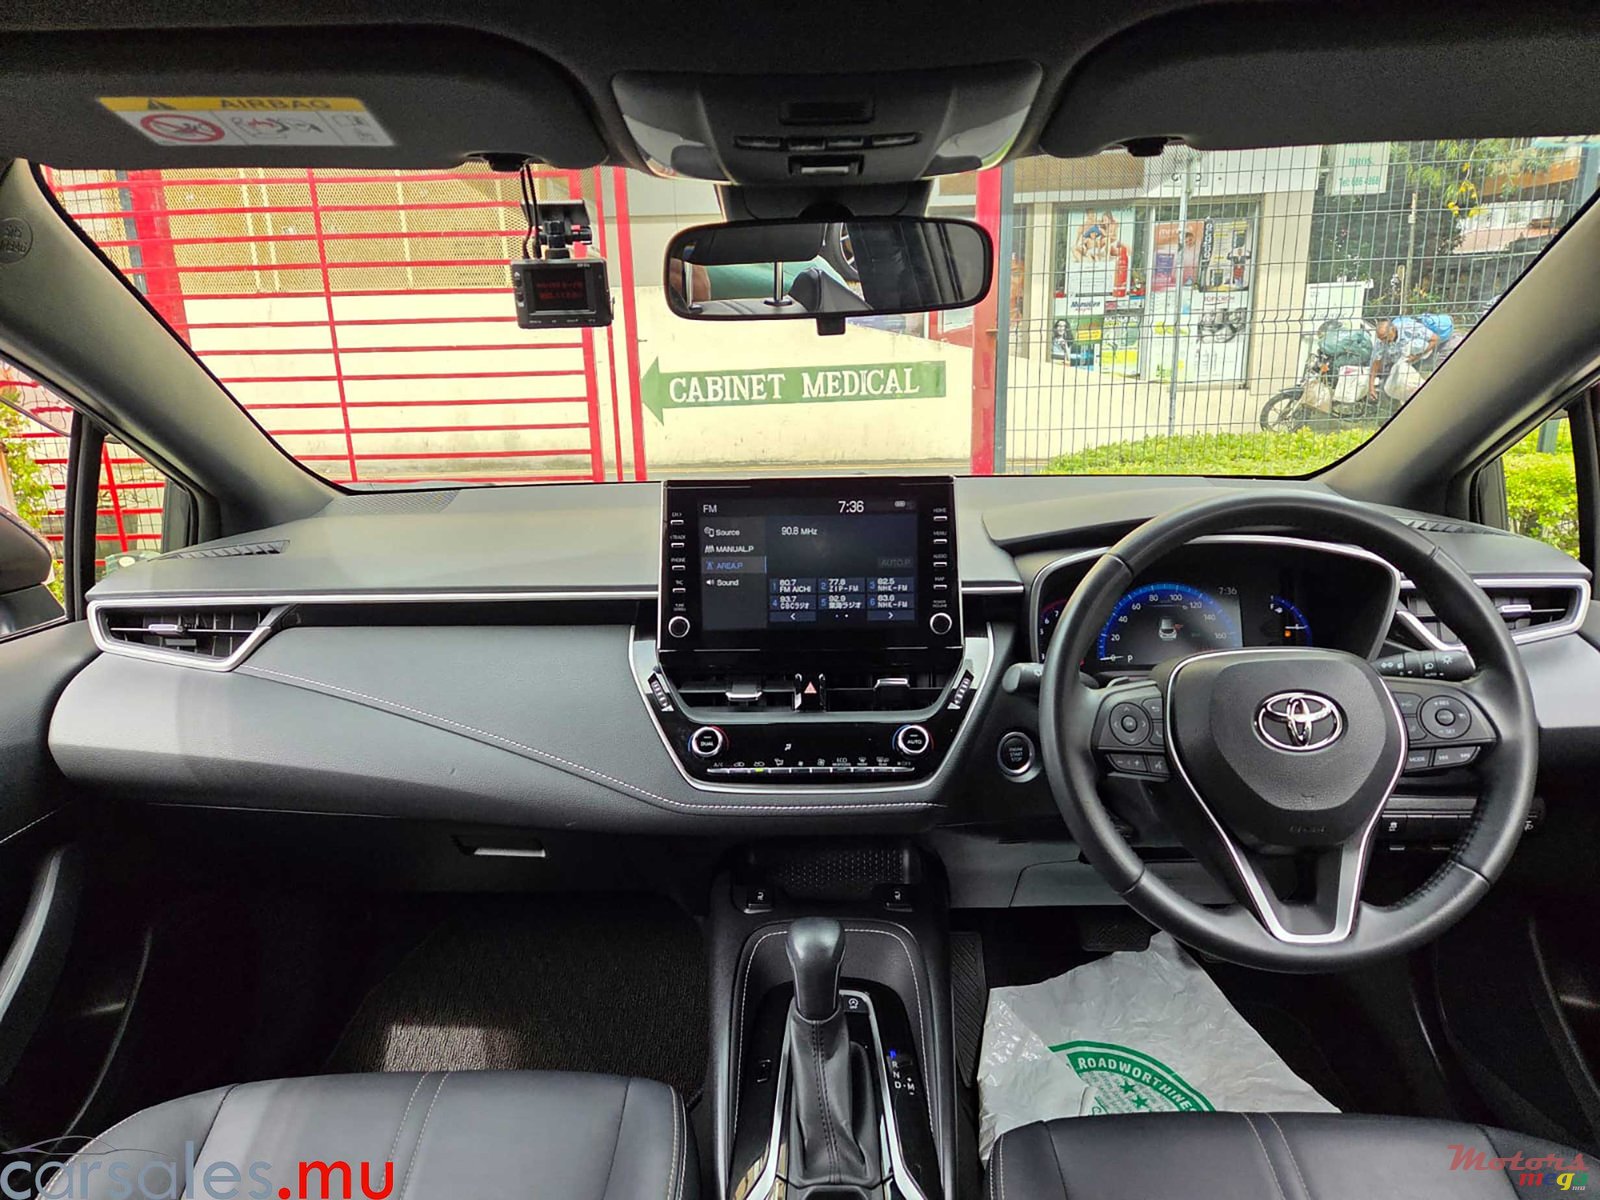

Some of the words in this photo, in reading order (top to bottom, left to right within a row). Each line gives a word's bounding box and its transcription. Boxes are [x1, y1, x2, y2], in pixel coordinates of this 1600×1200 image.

[220, 99, 332, 109] AIRBAG
[668, 374, 786, 404] CABINET
[801, 368, 920, 399] MEDICAL
[703, 505, 718, 513] FM
[838, 501, 865, 513] 7:36
[781, 527, 799, 536] 90.8
[801, 528, 817, 536] MHz
[1218, 586, 1237, 595] 7:36
[1149, 594, 1158, 602] 80
[1131, 602, 1141, 611] 60
[1118, 615, 1128, 623] 40
[892, 1060, 898, 1068] R
[893, 1071, 900, 1079] N
[894, 1081, 902, 1089] D
[1078, 1057, 1197, 1112] ROADWORTHINE
